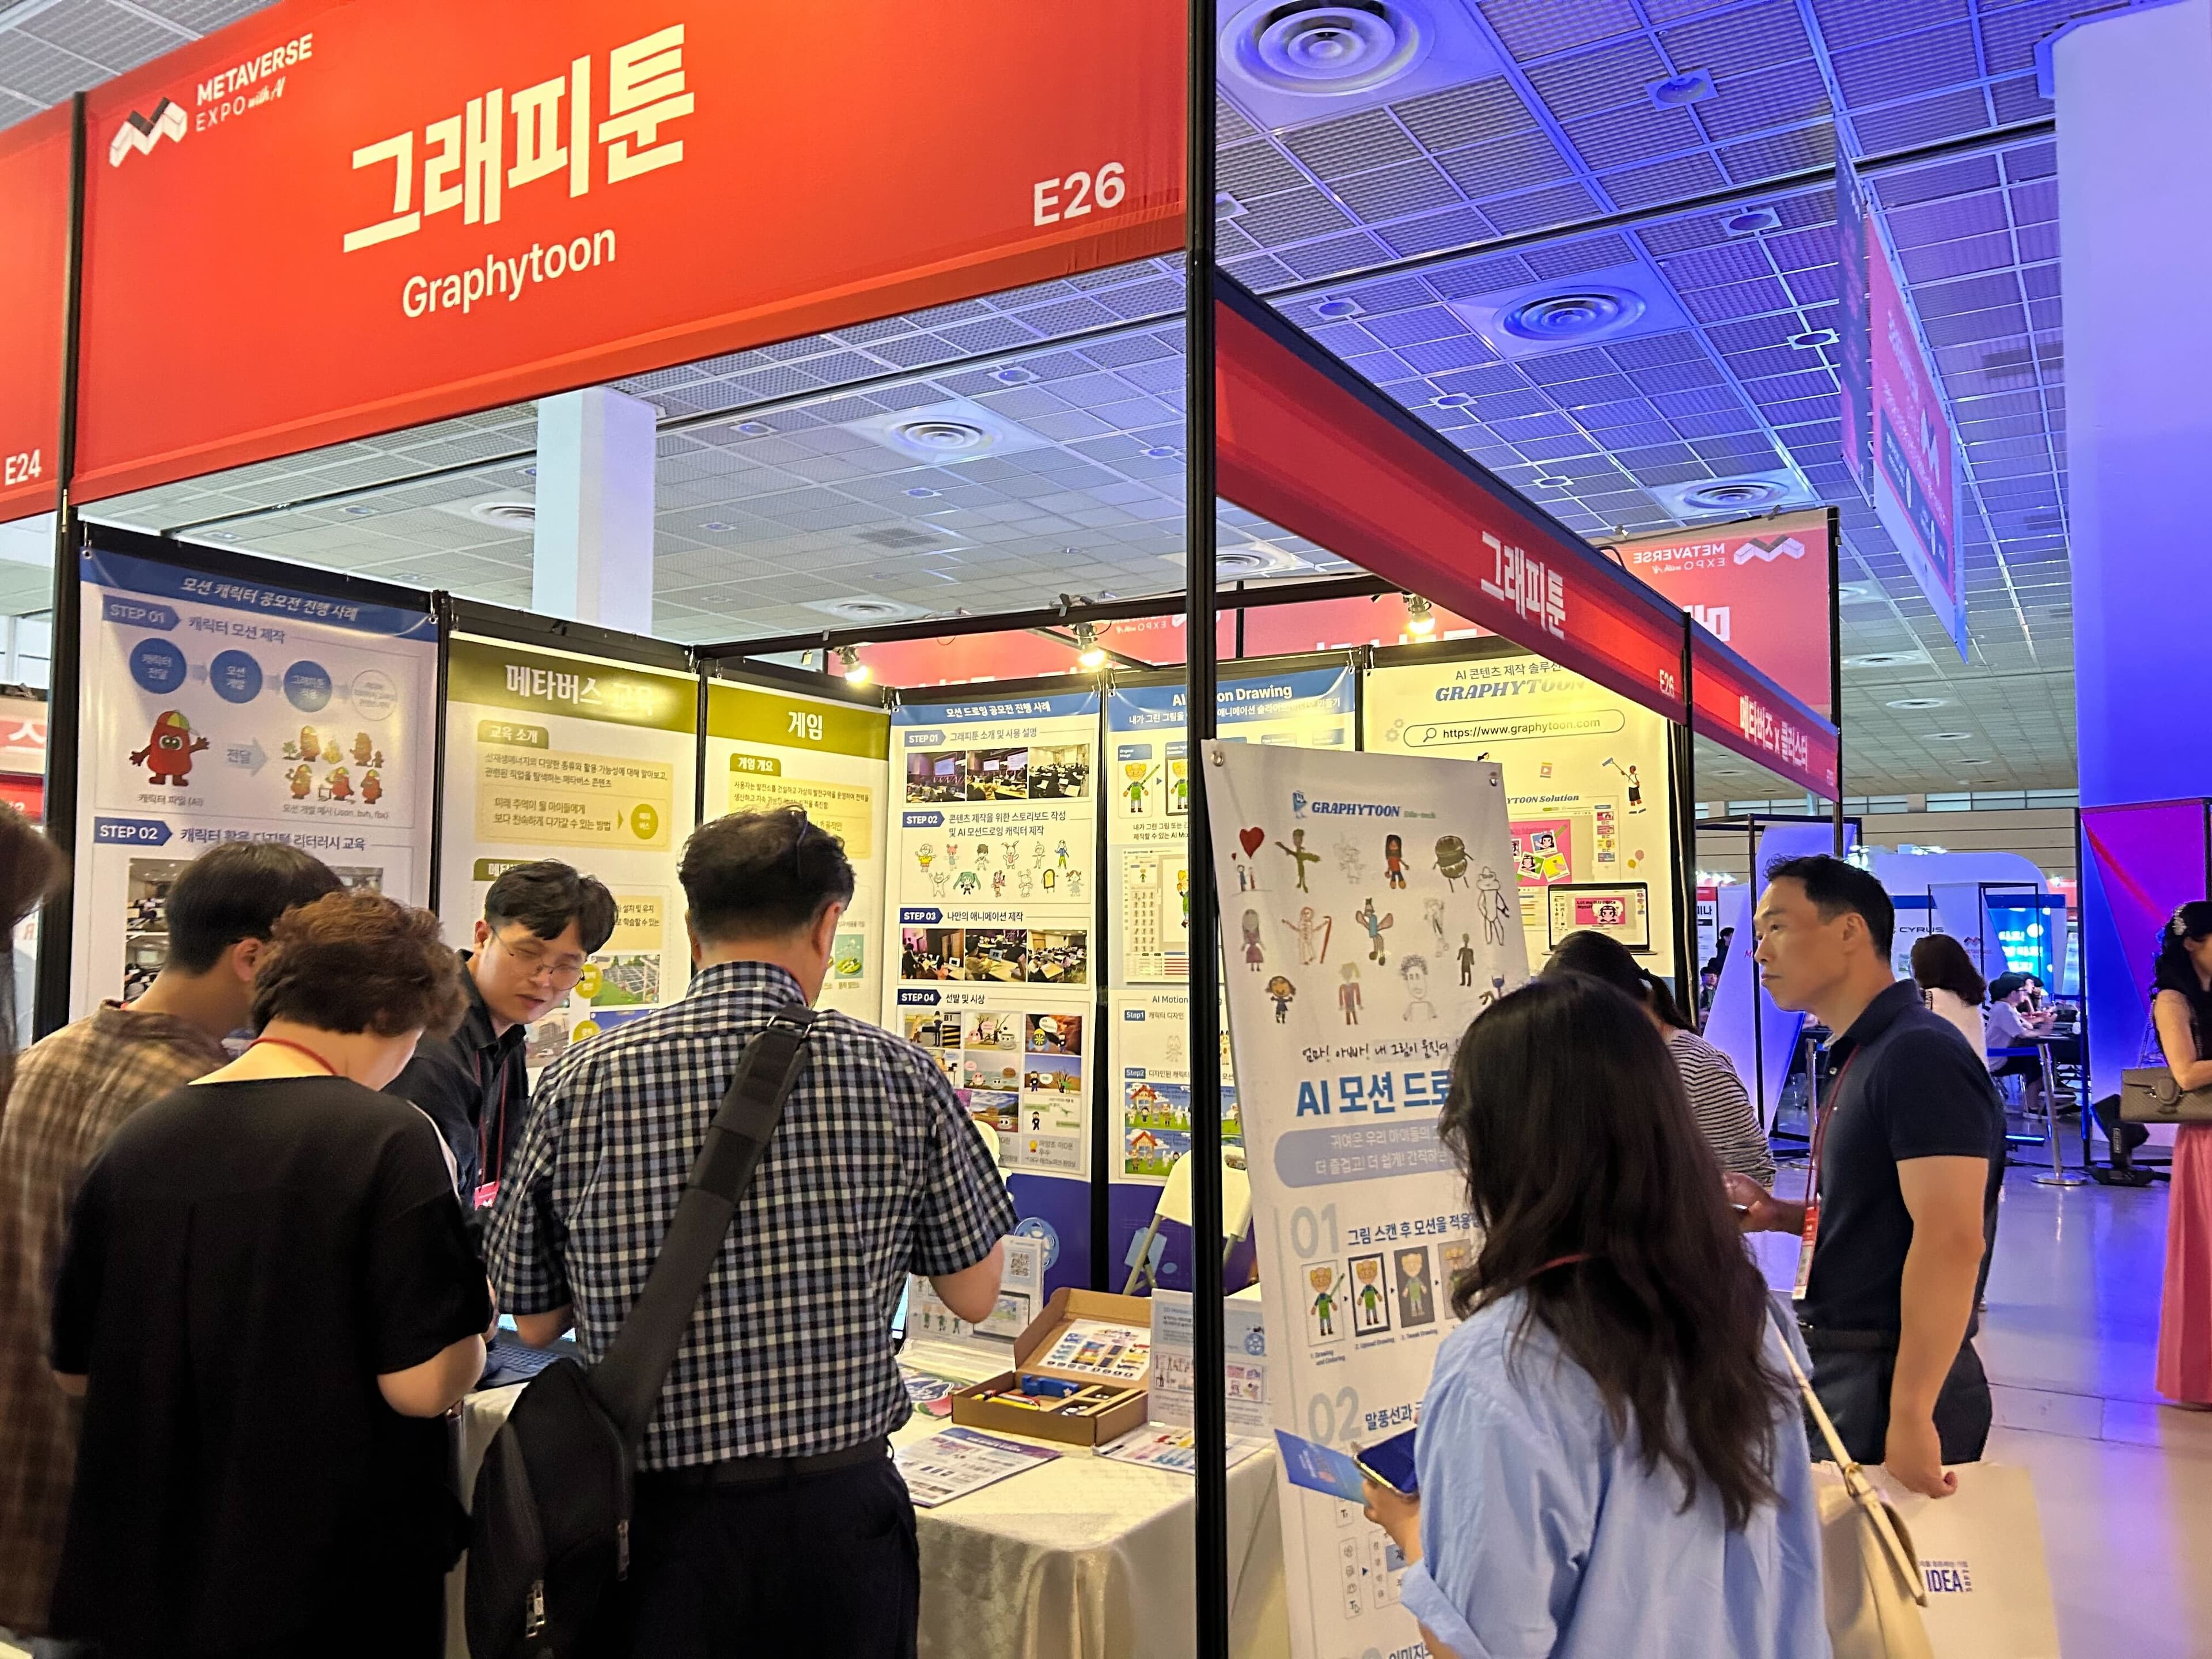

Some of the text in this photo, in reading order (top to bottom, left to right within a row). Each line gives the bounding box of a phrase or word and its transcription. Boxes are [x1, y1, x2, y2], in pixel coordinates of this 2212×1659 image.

[197, 32, 313, 106] METAVERSE
[196, 96, 246, 131] EXPO
[344, 24, 694, 253] 그래피툰
[1034, 161, 1125, 226] E26
[402, 228, 616, 318] Graphytoon
[5, 449, 41, 486] E24
[1481, 531, 1566, 641] 그래피툰
[181, 577, 358, 622] 모션 캐릭터 공모전 진행 사례
[110, 604, 165, 623] STEP 01
[189, 616, 286, 645] 캐릭터 모션 제작
[1456, 661, 1562, 680] AI 콘텐츠 제작 솔루션
[505, 664, 603, 706] 메타버스
[1435, 677, 1586, 702] GRAPHYTOON
[1659, 669, 1675, 699] E26
[1173, 694, 1186, 706] AI
[1236, 685, 1292, 702] Drawing
[946, 700, 1051, 718] 모션 드로잉 공모전 진행 사례
[1129, 715, 1145, 725] 내가
[1146, 713, 1160, 724] 그린
[1162, 711, 1184, 723] 그림을
[488, 725, 538, 744] 교육 소개
[788, 711, 823, 741] 게임
[950, 731, 978, 741] 그래피툰
[980, 729, 995, 740] 소개
[997, 729, 1004, 739] 및
[1022, 726, 1037, 737] 설명
[1443, 719, 1600, 739] https://www.graphytoon.com
[908, 734, 938, 744] STEP 01
[738, 757, 774, 772] 게임 개요
[1539, 794, 1579, 803] Solution
[949, 810, 1066, 824] 콘텐츠 제작을 위한 스토리보드 작성
[1312, 801, 1400, 817] GRAPHYTOON
[907, 815, 938, 824] STEP 02
[100, 824, 158, 840] STEP 02
[180, 828, 366, 851] 캐릭터 리터러시 교육
[949, 824, 1044, 838] 및 AI 모션드로잉 캐릭터 제작
[903, 912, 937, 921] STEP 03
[947, 911, 1024, 922] 나만의 애니메이션 제작
[901, 993, 934, 1002] STEP 04
[945, 994, 985, 1005] 선발 및 시상
[1162, 995, 1188, 1003] Motion
[1126, 1012, 1144, 1020] Step1
[1375, 1044, 1386, 1055] 내
[1391, 1042, 1417, 1058] 그림이
[1126, 1069, 1145, 1077] Step2
[1296, 1070, 1452, 1116] AI 모션 드로
[1330, 1131, 1363, 1150] 귀여운
[1366, 1130, 1387, 1145] 우리
[1316, 1160, 1326, 1175] 더
[1368, 1154, 1378, 1170] 더
[1290, 1203, 1339, 1259] 01
[1348, 1227, 1371, 1245] 그림
[1374, 1223, 1396, 1241] 스캔
[1400, 1221, 1411, 1237] 후
[1414, 1216, 1446, 1236] 모션을
[1308, 1386, 1362, 1442] 02
[1365, 1403, 1412, 1431] 말풍선과
[1925, 1569, 1964, 1592] IDEA
